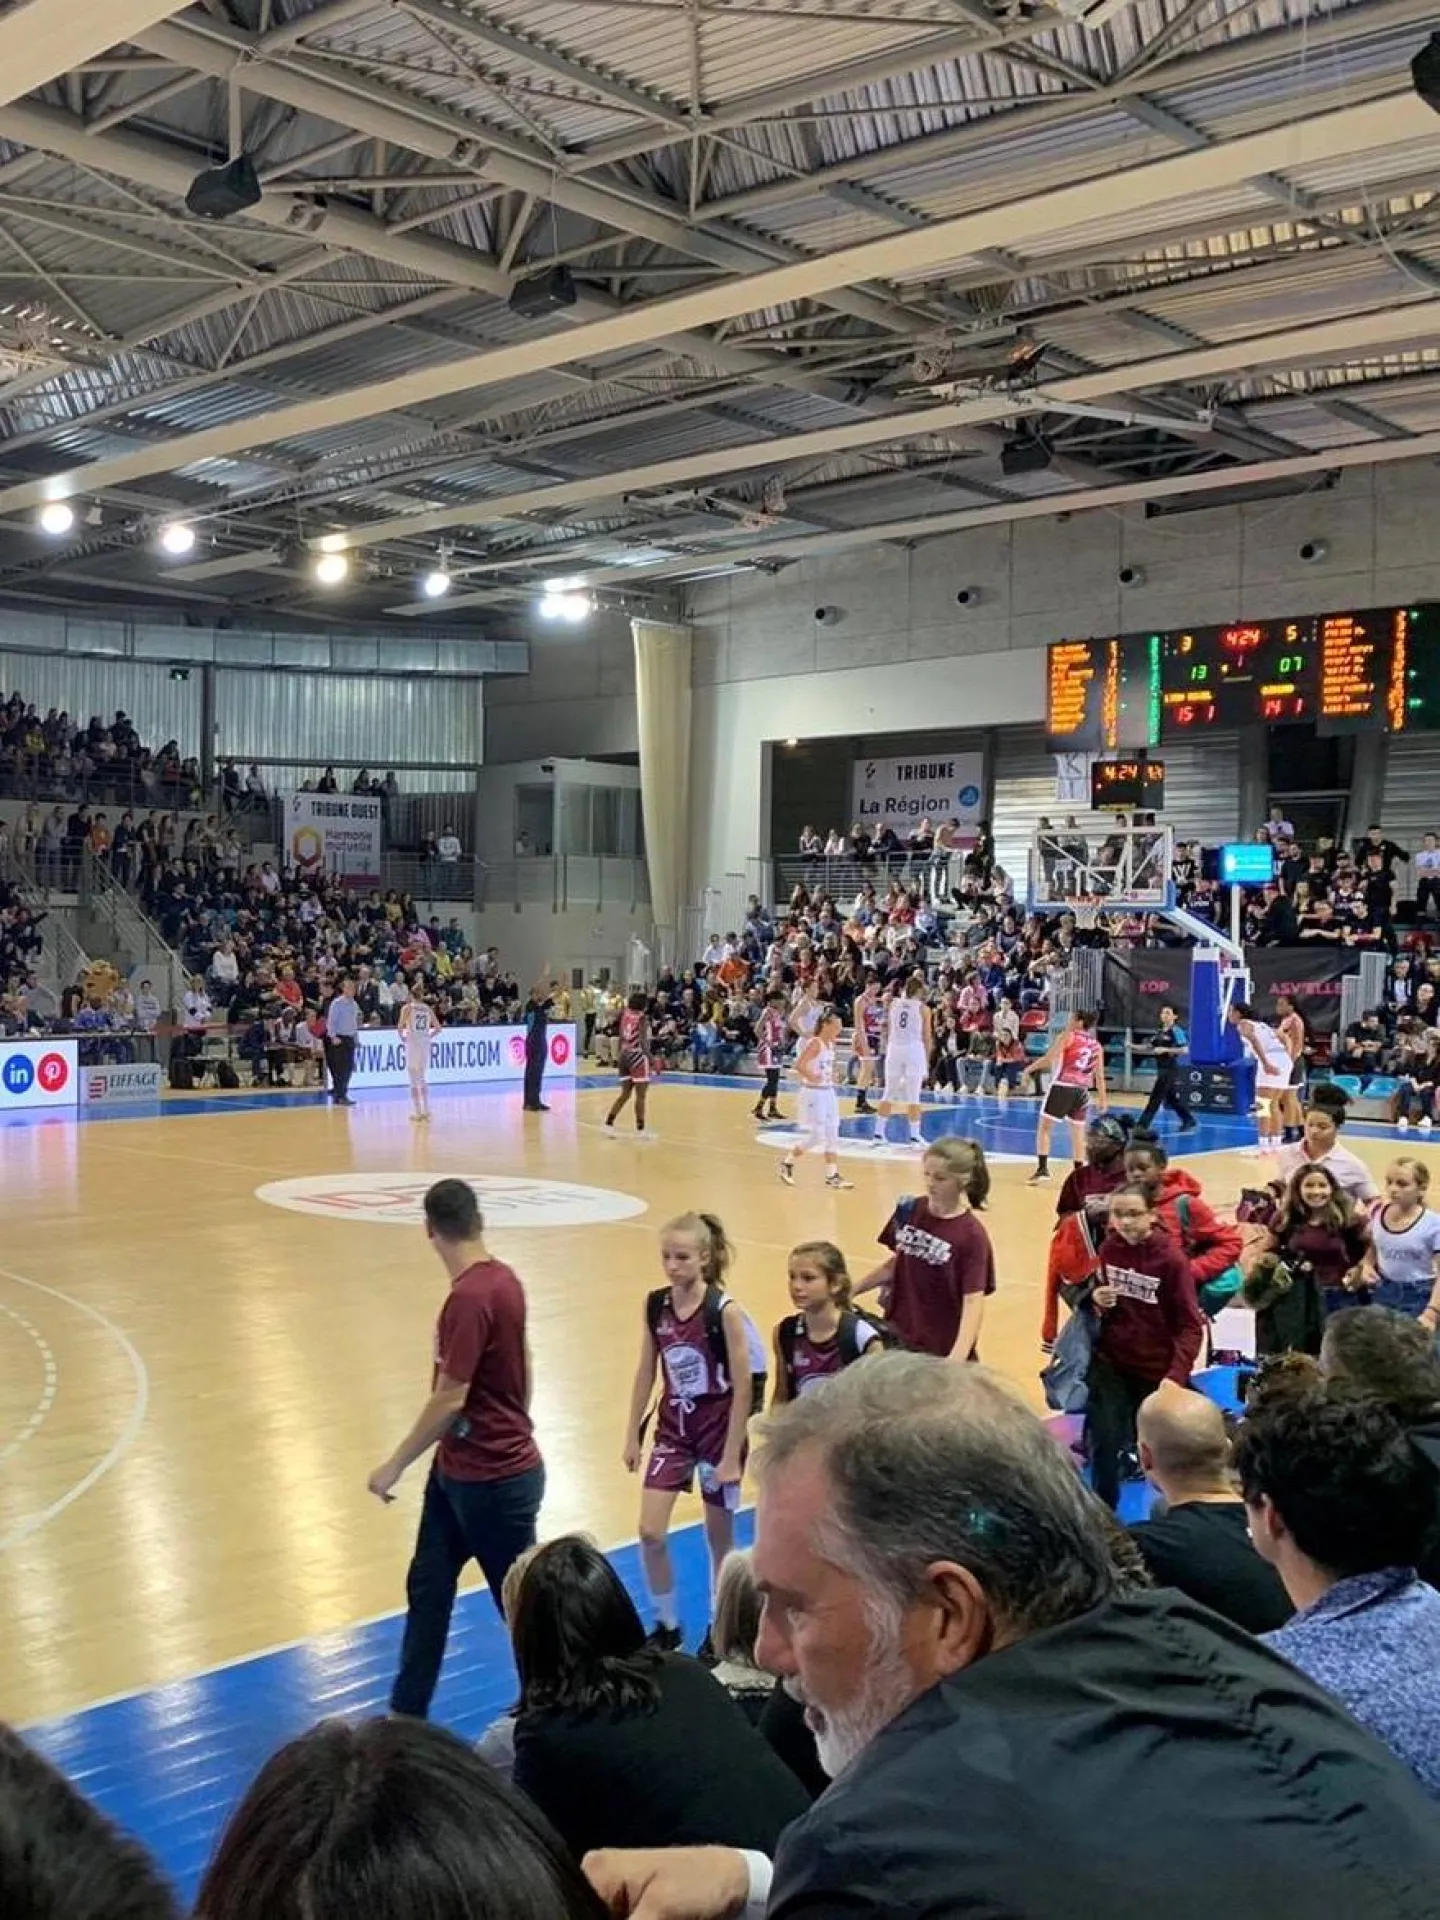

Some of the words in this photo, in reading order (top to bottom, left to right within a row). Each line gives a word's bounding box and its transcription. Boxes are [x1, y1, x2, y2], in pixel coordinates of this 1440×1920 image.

[1190, 664, 1208, 682] 13
[898, 761, 955, 780] TRIBUNE
[311, 801, 350, 817] TRIBUNE
[351, 803, 379, 819] OUEST
[859, 798, 880, 814] La
[884, 794, 950, 816] Région
[1139, 980, 1170, 994] KOP
[415, 1013, 428, 1031] 23
[899, 1010, 909, 1029] 8
[10, 1064, 29, 1085] in
[652, 1457, 666, 1476] 7
